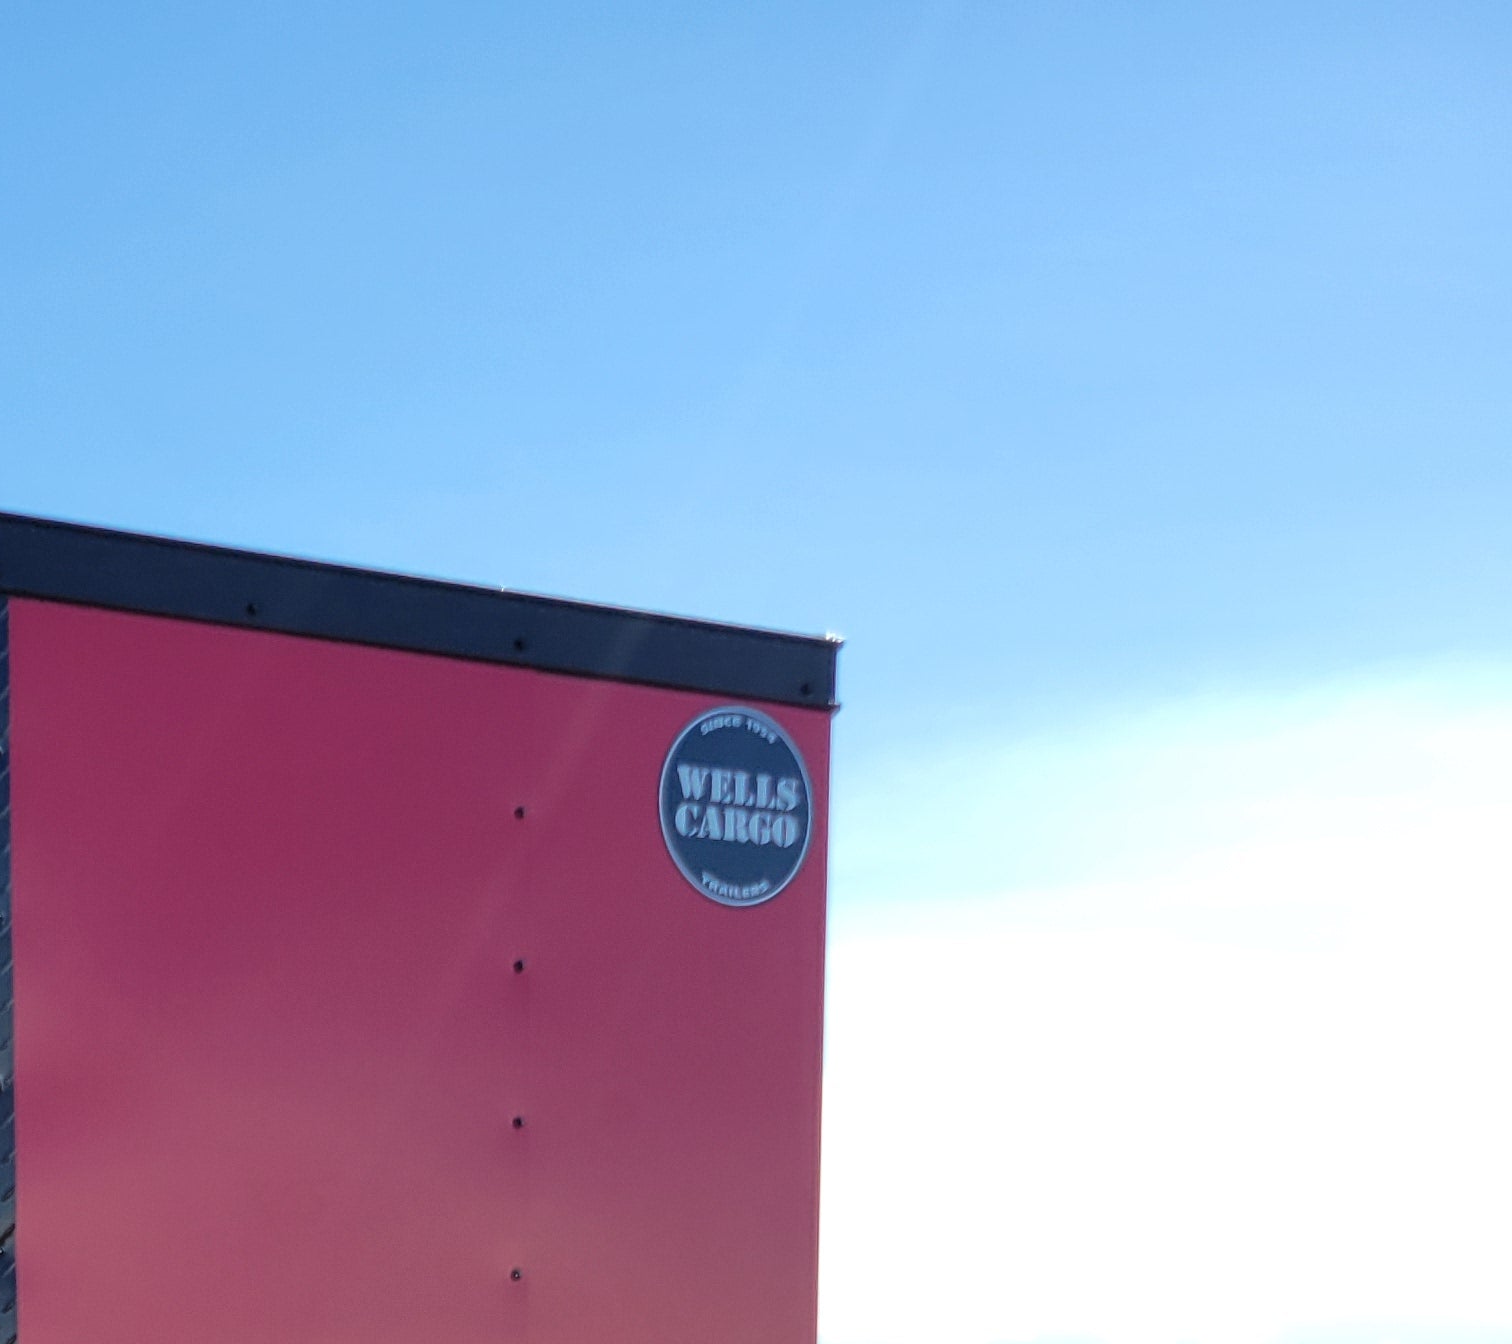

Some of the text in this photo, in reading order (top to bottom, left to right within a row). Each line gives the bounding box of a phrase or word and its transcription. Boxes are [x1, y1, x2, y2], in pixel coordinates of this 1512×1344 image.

[700, 715, 743, 736] SINCE
[677, 765, 799, 811] WELLS
[675, 803, 799, 848] CARGO
[701, 871, 771, 899] TRAILERS
